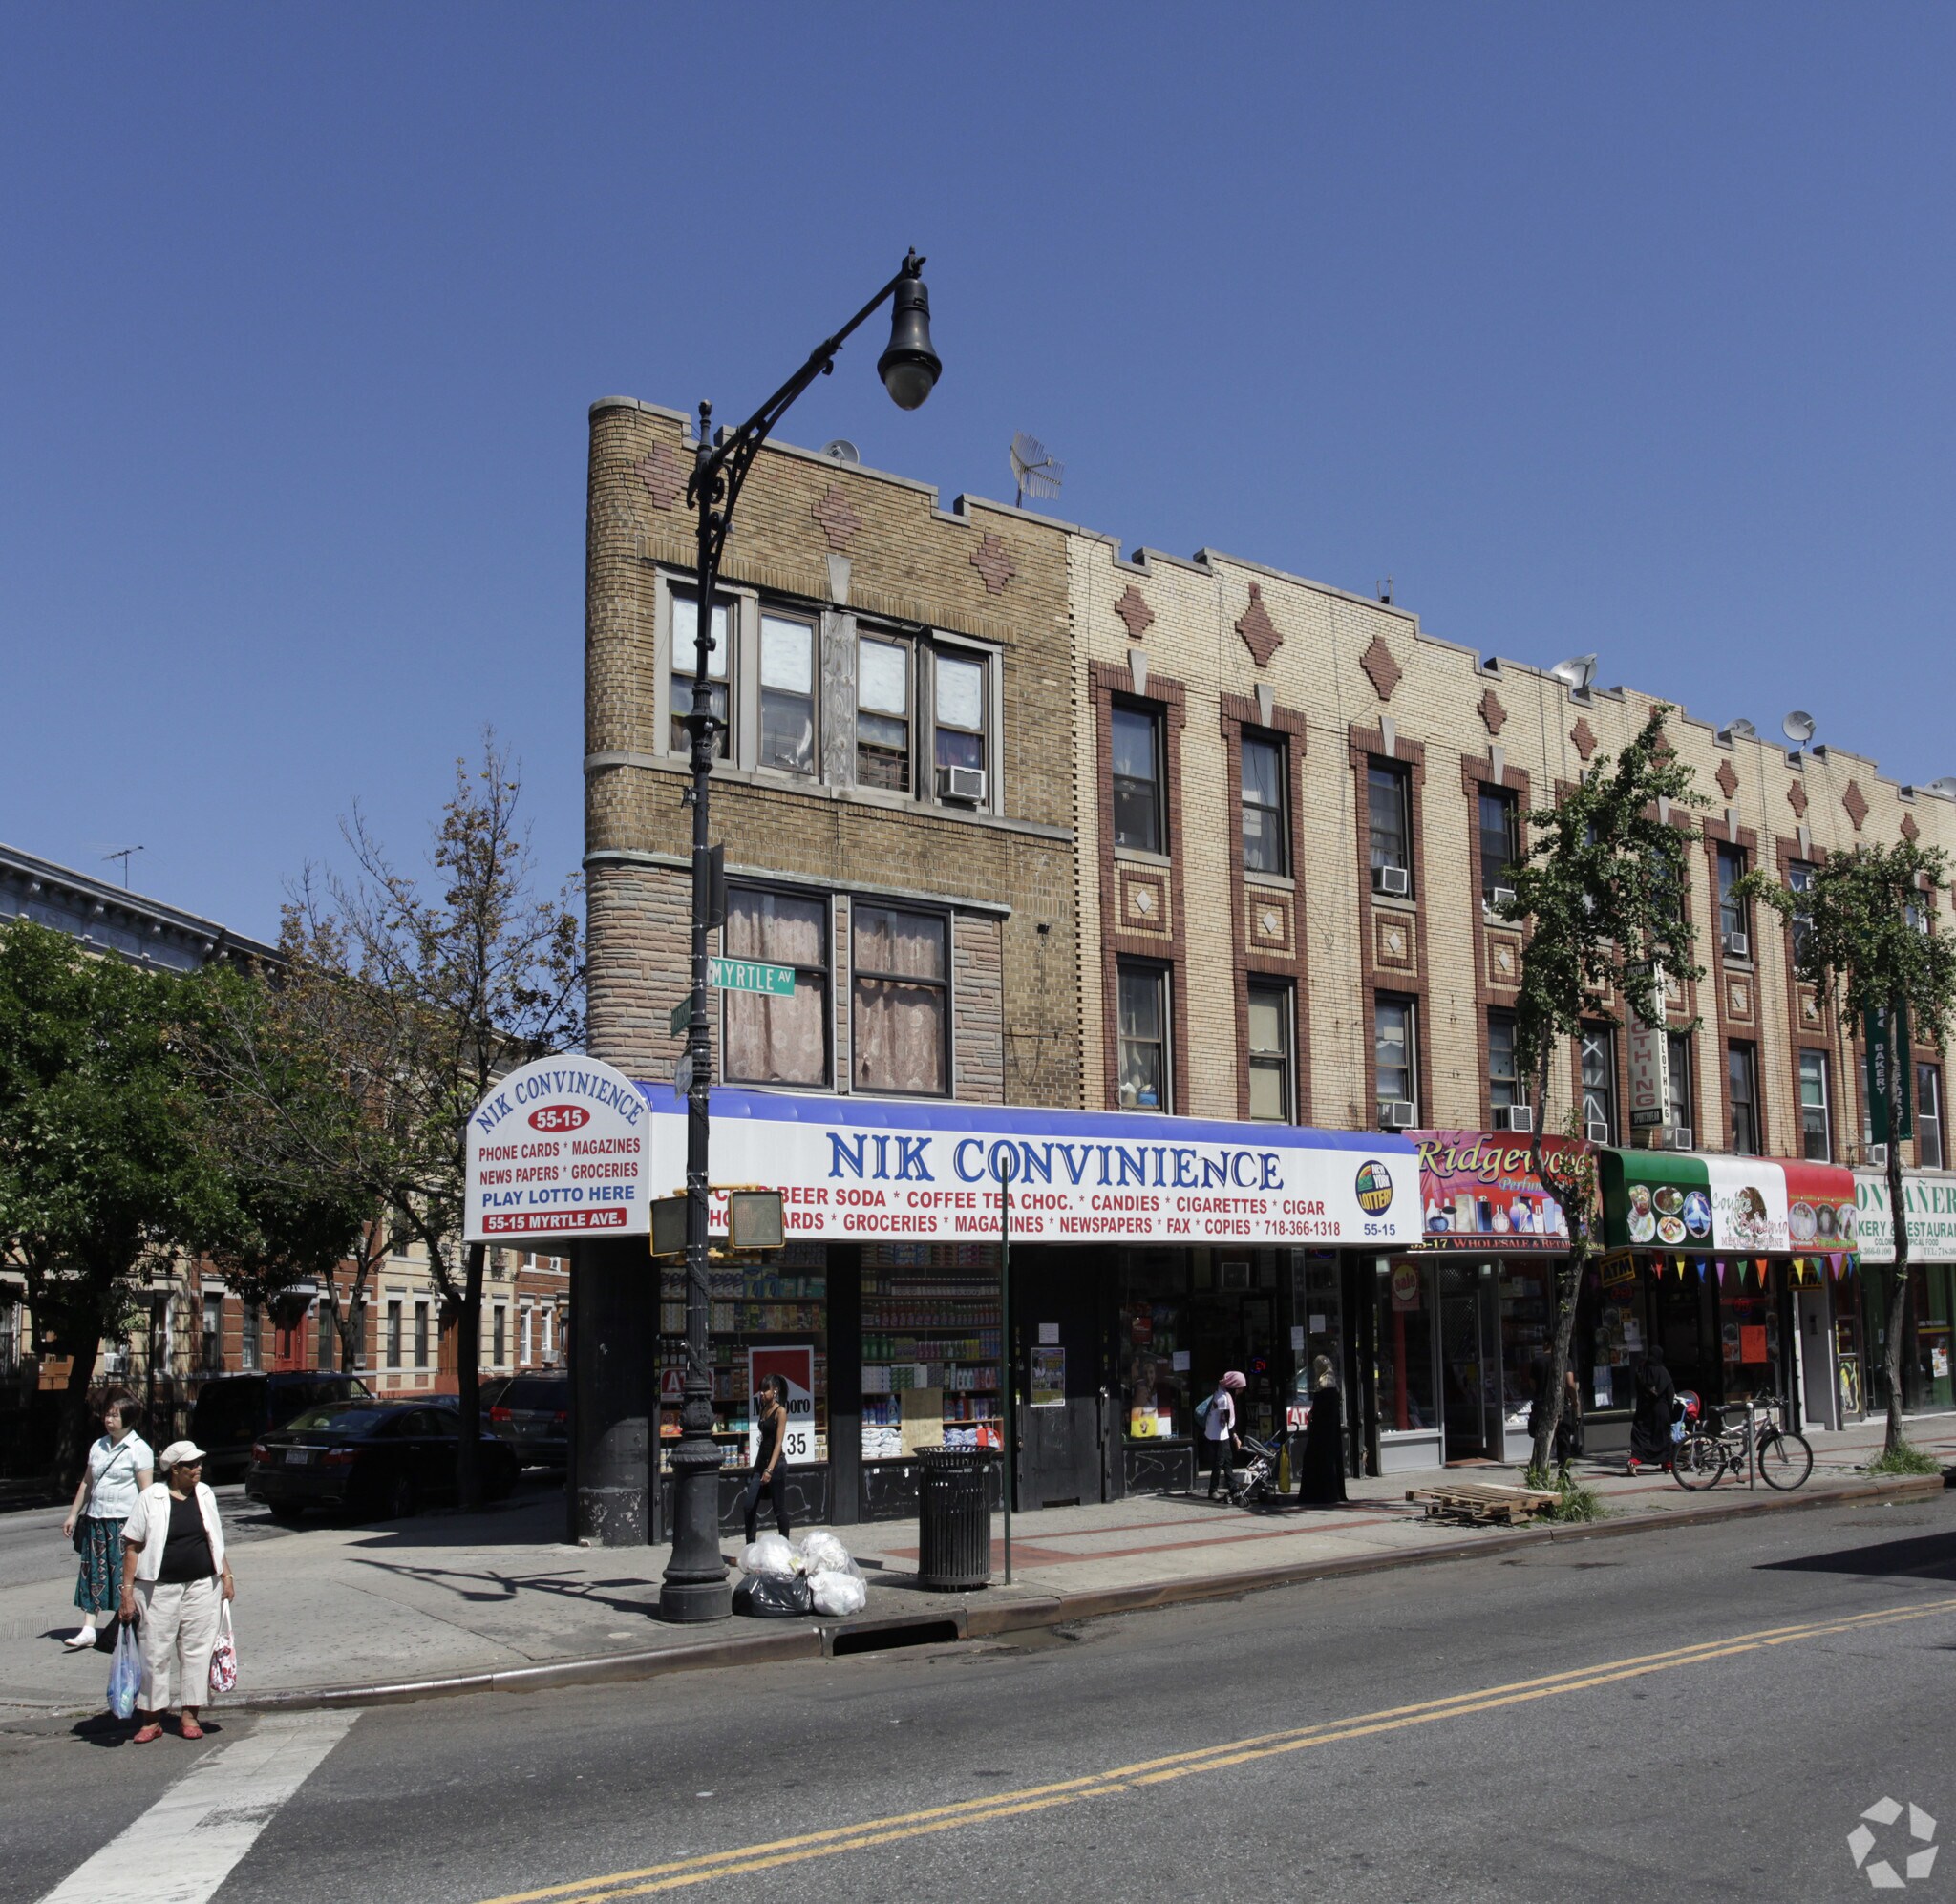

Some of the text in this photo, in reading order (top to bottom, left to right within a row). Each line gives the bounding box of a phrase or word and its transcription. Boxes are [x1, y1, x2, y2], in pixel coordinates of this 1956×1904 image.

[712, 961, 792, 991] MYRTLE AV
[1660, 1034, 1670, 1118] CLOTHING
[1874, 1043, 1886, 1095] BAKERY
[476, 1070, 645, 1135] NIK CONVINIENCE
[536, 1110, 583, 1129] 55-15
[478, 1138, 641, 1162] PHONE CARDS MAGAZINES
[826, 1132, 1284, 1191] NIK CONVINIENCE
[479, 1162, 638, 1185] NEWS PAPERS GROCERIES
[1371, 1164, 1386, 1174] NEW
[1373, 1174, 1391, 1189] YORK
[1499, 1175, 1544, 1192] Perfum
[482, 1185, 635, 1208] PLAY LOTTO HERE
[777, 1186, 829, 1205] BEER
[836, 1188, 886, 1207] SODA
[907, 1191, 976, 1209] COFFEE
[982, 1193, 1016, 1209] TEA
[1021, 1194, 1073, 1210] CHOC.
[1091, 1195, 1159, 1212] CANDIES
[1176, 1196, 1267, 1214] CIGARETTES
[1283, 1200, 1325, 1216] CIGAR
[1358, 1187, 1392, 1210] LOTTERY
[488, 1212, 622, 1230] 55-15 MYRTLE AVE.
[783, 1212, 1341, 1236] ARDS GROCERIES MAGAINES NEWSPAPERS FAX COPIES 718-366-1318
[1364, 1223, 1396, 1236] 55-15
[1532, 1239, 1540, 1249] &
[1925, 1238, 1939, 1247] FOOD
[1604, 1259, 1632, 1281] ATM
[787, 1433, 806, 1455] 35
